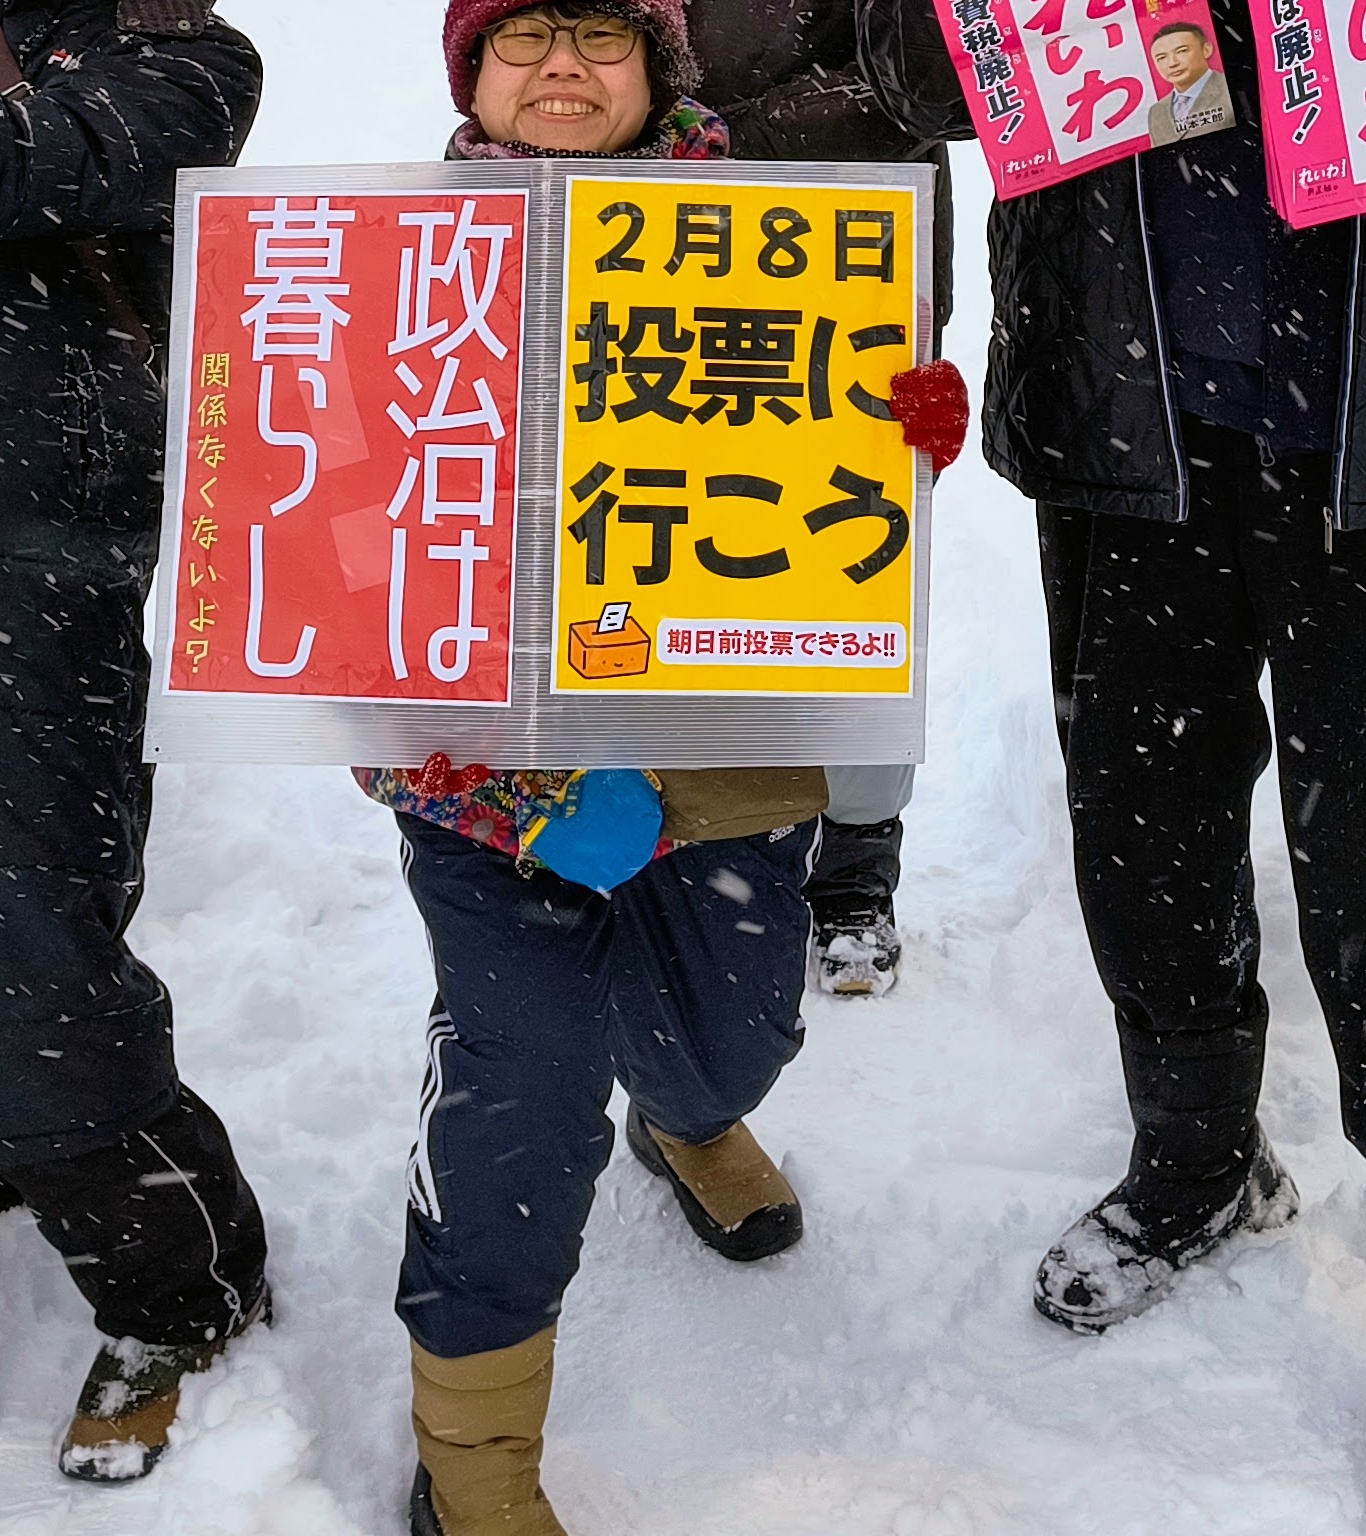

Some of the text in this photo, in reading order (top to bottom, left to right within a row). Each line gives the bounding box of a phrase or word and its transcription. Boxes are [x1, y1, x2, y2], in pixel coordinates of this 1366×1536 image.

[594, 201, 897, 284] 2月8日
[573, 300, 909, 427] 投票に
[241, 196, 352, 680] 暮らし
[387, 199, 513, 683] 政治は
[568, 460, 912, 586] 行こう
